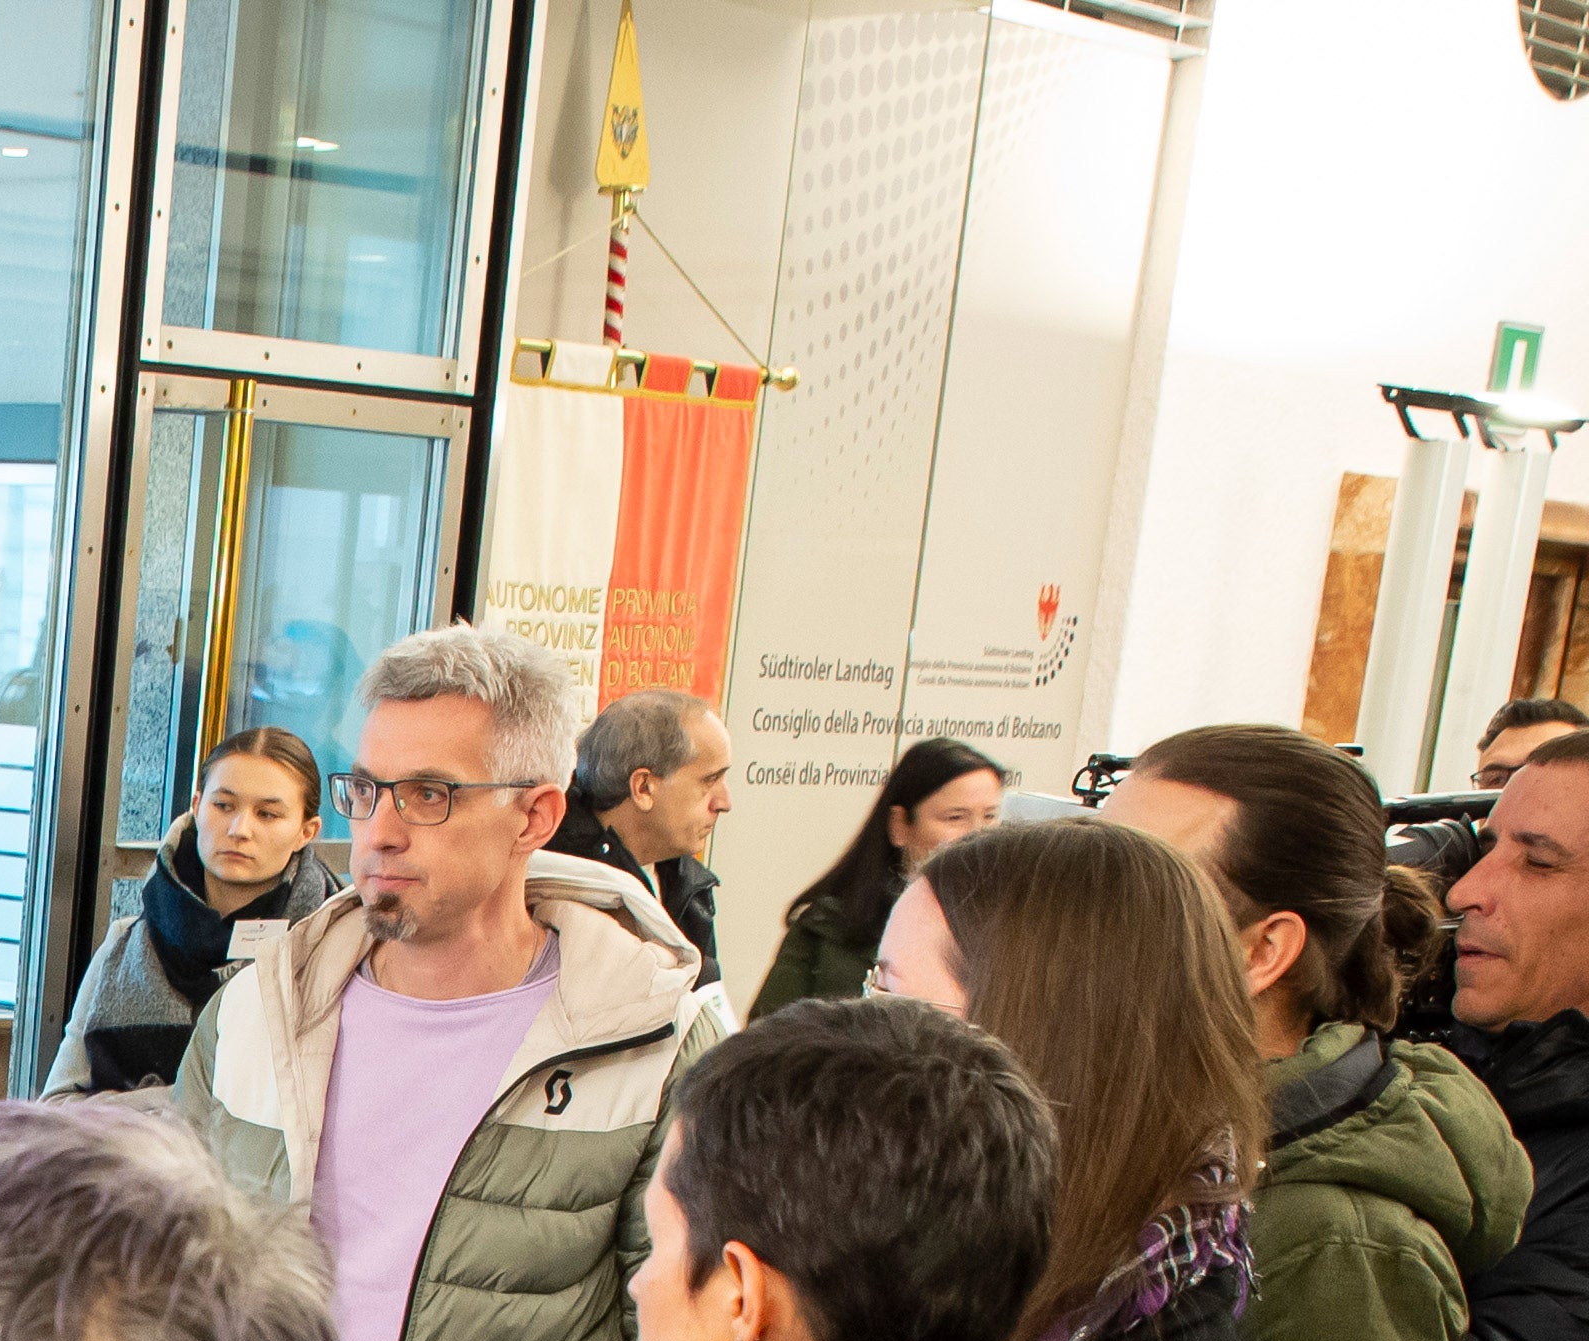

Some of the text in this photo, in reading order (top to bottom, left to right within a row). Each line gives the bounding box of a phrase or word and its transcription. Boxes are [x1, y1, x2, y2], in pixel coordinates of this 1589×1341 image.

[609, 624, 695, 652] AUTONOM
[607, 661, 624, 686] DI
[627, 661, 695, 687] BOLZAN
[758, 653, 832, 681] Südtiroler
[835, 658, 894, 690] Landtag
[752, 707, 821, 739] Consiglio
[824, 709, 858, 734] della
[926, 716, 993, 738] autonoma
[996, 714, 1010, 738] di
[1012, 715, 1062, 740] Bolzano
[746, 761, 891, 787] Consëi dla Provinzia
